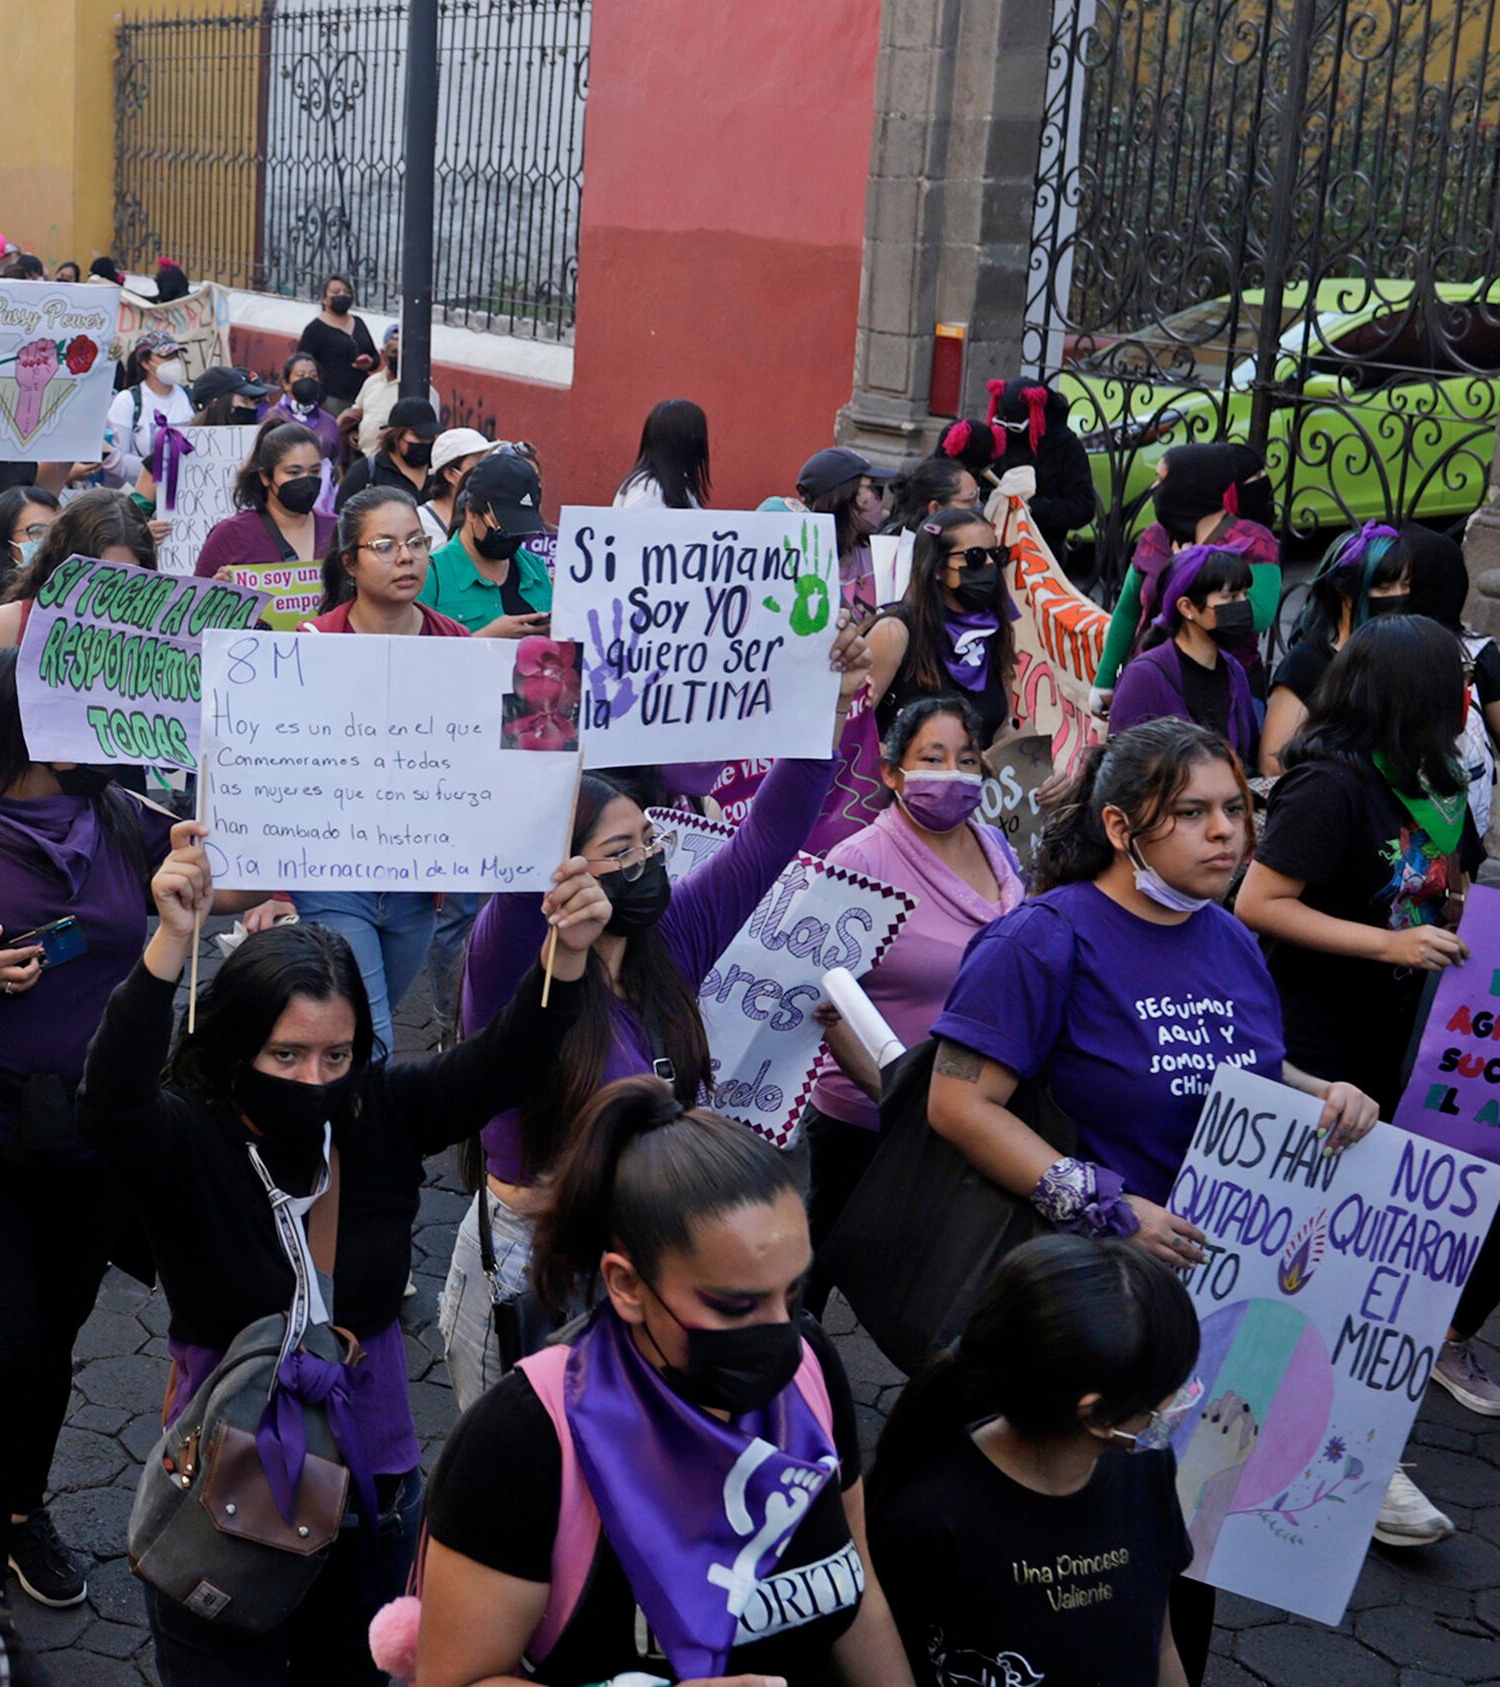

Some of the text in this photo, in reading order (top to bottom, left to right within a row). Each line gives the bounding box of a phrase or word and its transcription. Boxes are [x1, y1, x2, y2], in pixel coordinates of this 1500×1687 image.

[43, 299, 105, 330] Power
[187, 427, 222, 458] POR
[184, 463, 217, 489] POR
[176, 489, 207, 517] POR
[570, 526, 802, 586] Si mañana
[37, 558, 95, 610] SI
[236, 571, 258, 587] No
[263, 570, 292, 587] soy
[628, 584, 750, 638] Soy YO
[606, 635, 785, 679] quiero ser
[212, 688, 261, 744] Hoy
[275, 718, 302, 736] es
[308, 721, 333, 737] un
[388, 722, 409, 737] en
[414, 715, 435, 736] el
[446, 721, 483, 746] que
[584, 690, 611, 730] la
[87, 706, 198, 767] TODAS
[373, 756, 386, 769] a
[395, 750, 452, 771] todas
[210, 773, 493, 811] las mujeres que con su fuerza
[213, 806, 249, 836] han
[263, 819, 341, 841] cambiado
[350, 821, 368, 842] la
[426, 857, 448, 876] de
[453, 857, 470, 876] la
[1219, 1024, 1235, 1044] Y
[1149, 1048, 1257, 1073] SOMOS UN
[1194, 1090, 1277, 1168] NOS
[1391, 1139, 1486, 1217] NOS
[1168, 1165, 1292, 1257] QUITADO
[1329, 1193, 1480, 1289] QUITARON
[1332, 1315, 1435, 1402] MIEDO
[1012, 1548, 1130, 1585] Una Princesa
[1046, 1582, 1113, 1612] Valiente
